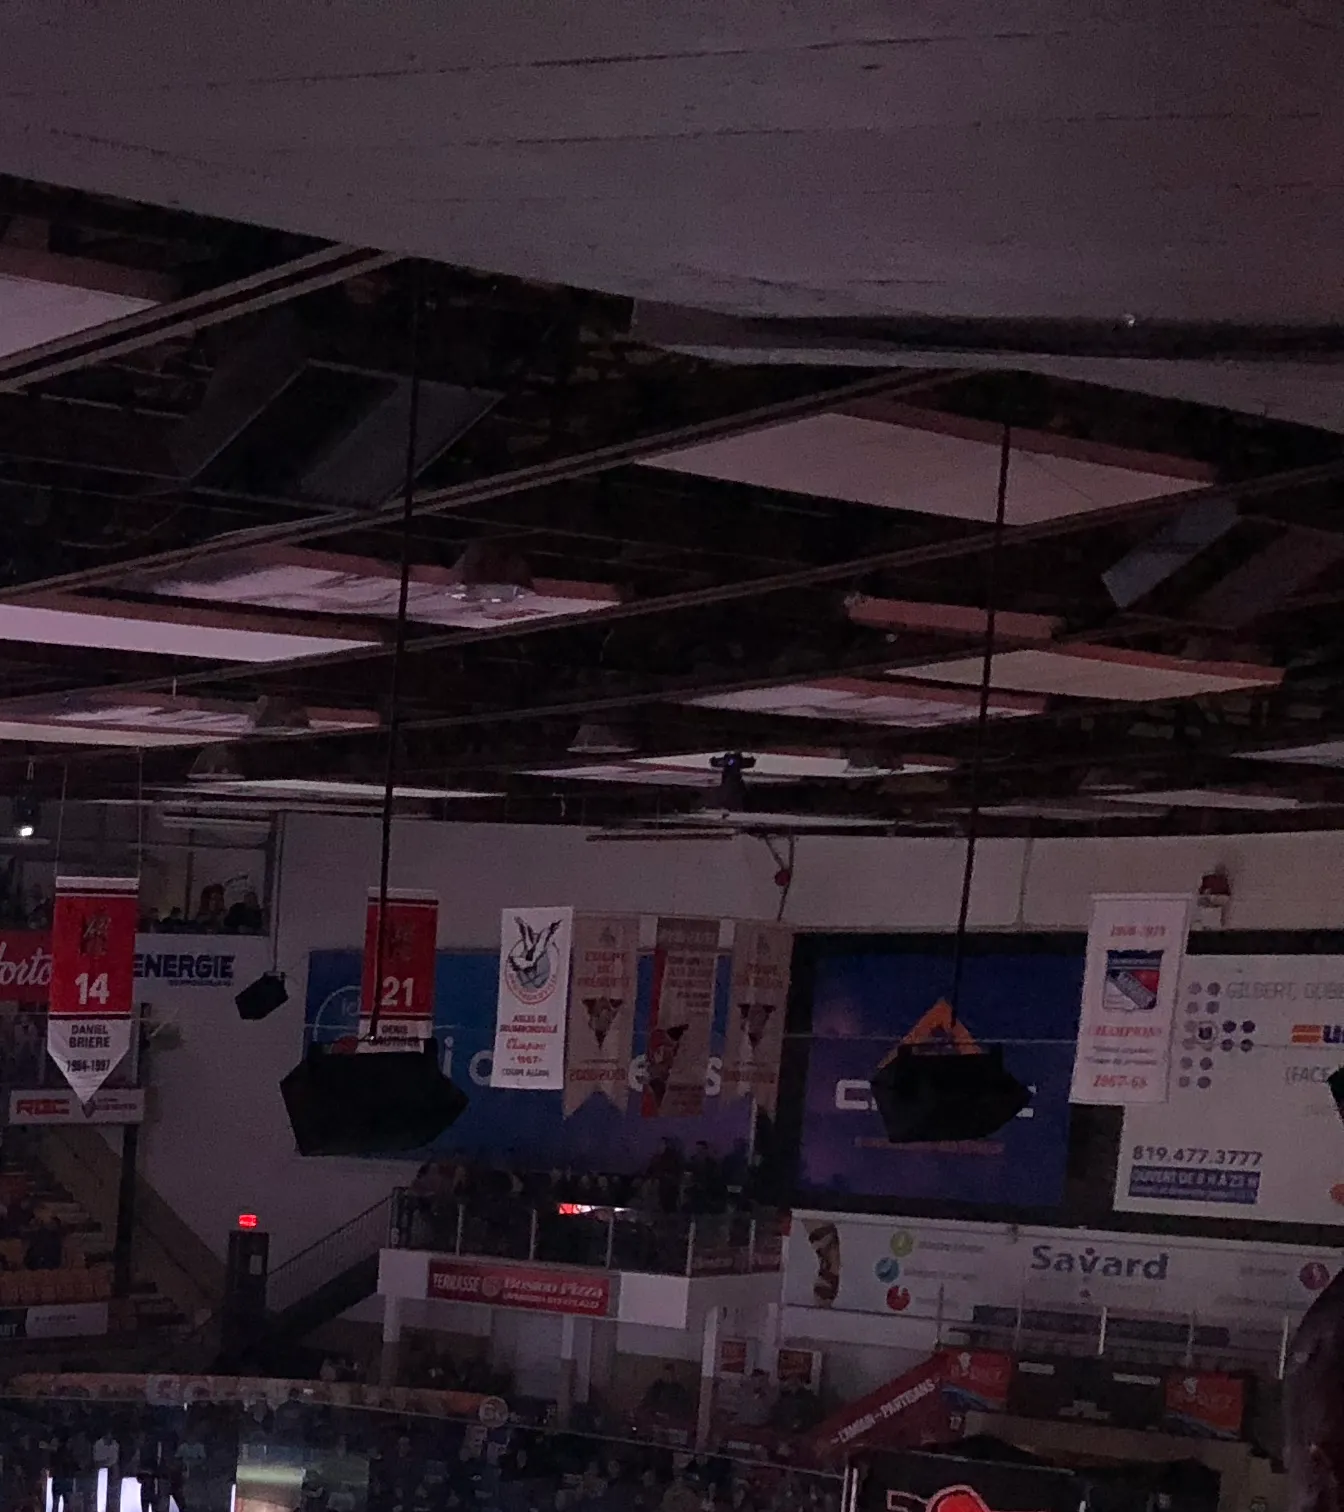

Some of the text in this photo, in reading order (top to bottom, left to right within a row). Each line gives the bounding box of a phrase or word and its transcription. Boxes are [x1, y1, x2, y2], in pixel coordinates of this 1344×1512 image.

[75, 972, 111, 1005] 14
[381, 975, 416, 1007] 21
[70, 1024, 109, 1035] DANIEL
[1031, 1243, 1170, 1281] Savard
